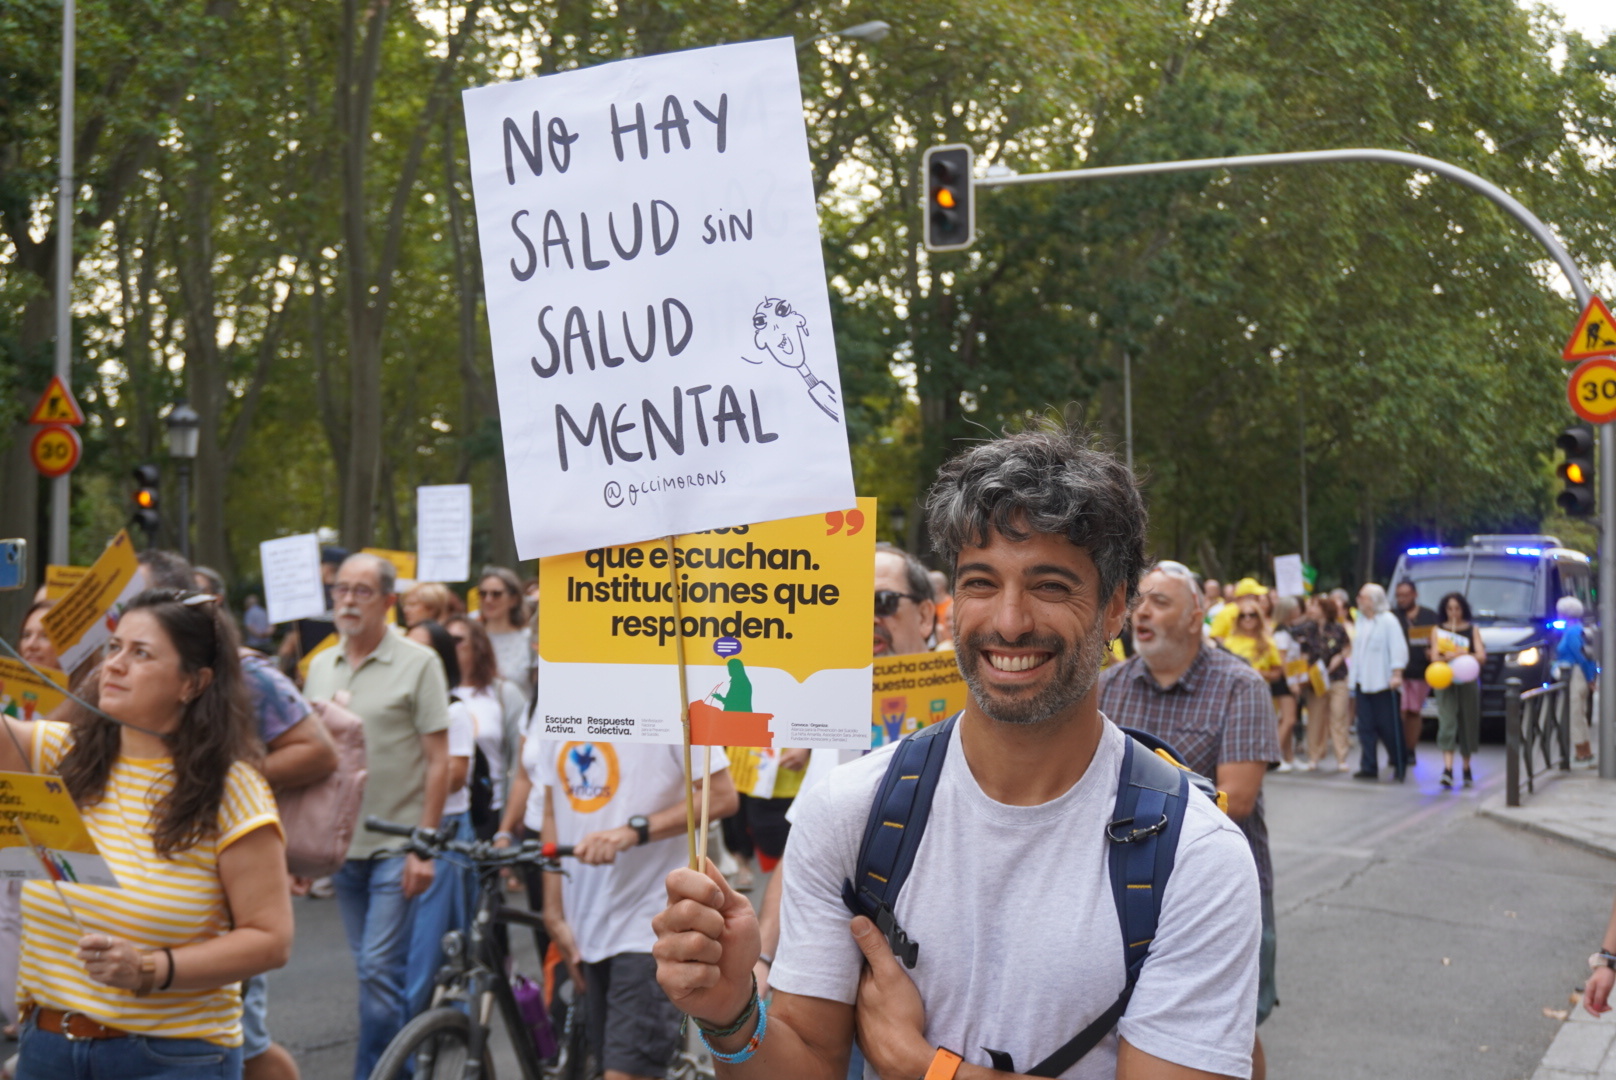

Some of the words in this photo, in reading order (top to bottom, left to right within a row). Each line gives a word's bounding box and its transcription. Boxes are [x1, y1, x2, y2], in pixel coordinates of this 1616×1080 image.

[611, 94, 727, 161] HAY
[511, 200, 679, 281] SALUD
[532, 298, 693, 378] SALUD
[1582, 379, 1616, 401] 30
[556, 385, 778, 471] MENTAL
[42, 442, 69, 460] 30
[585, 548, 644, 577] que
[649, 541, 820, 571] escuchan.
[567, 574, 768, 604] Instituciones
[773, 583, 840, 614] que
[612, 611, 793, 646] responden.
[545, 715, 582, 724] Escucha
[545, 725, 576, 734] Activa.
[587, 716, 635, 727] Respuesta
[587, 726, 632, 735] Colectiva.
